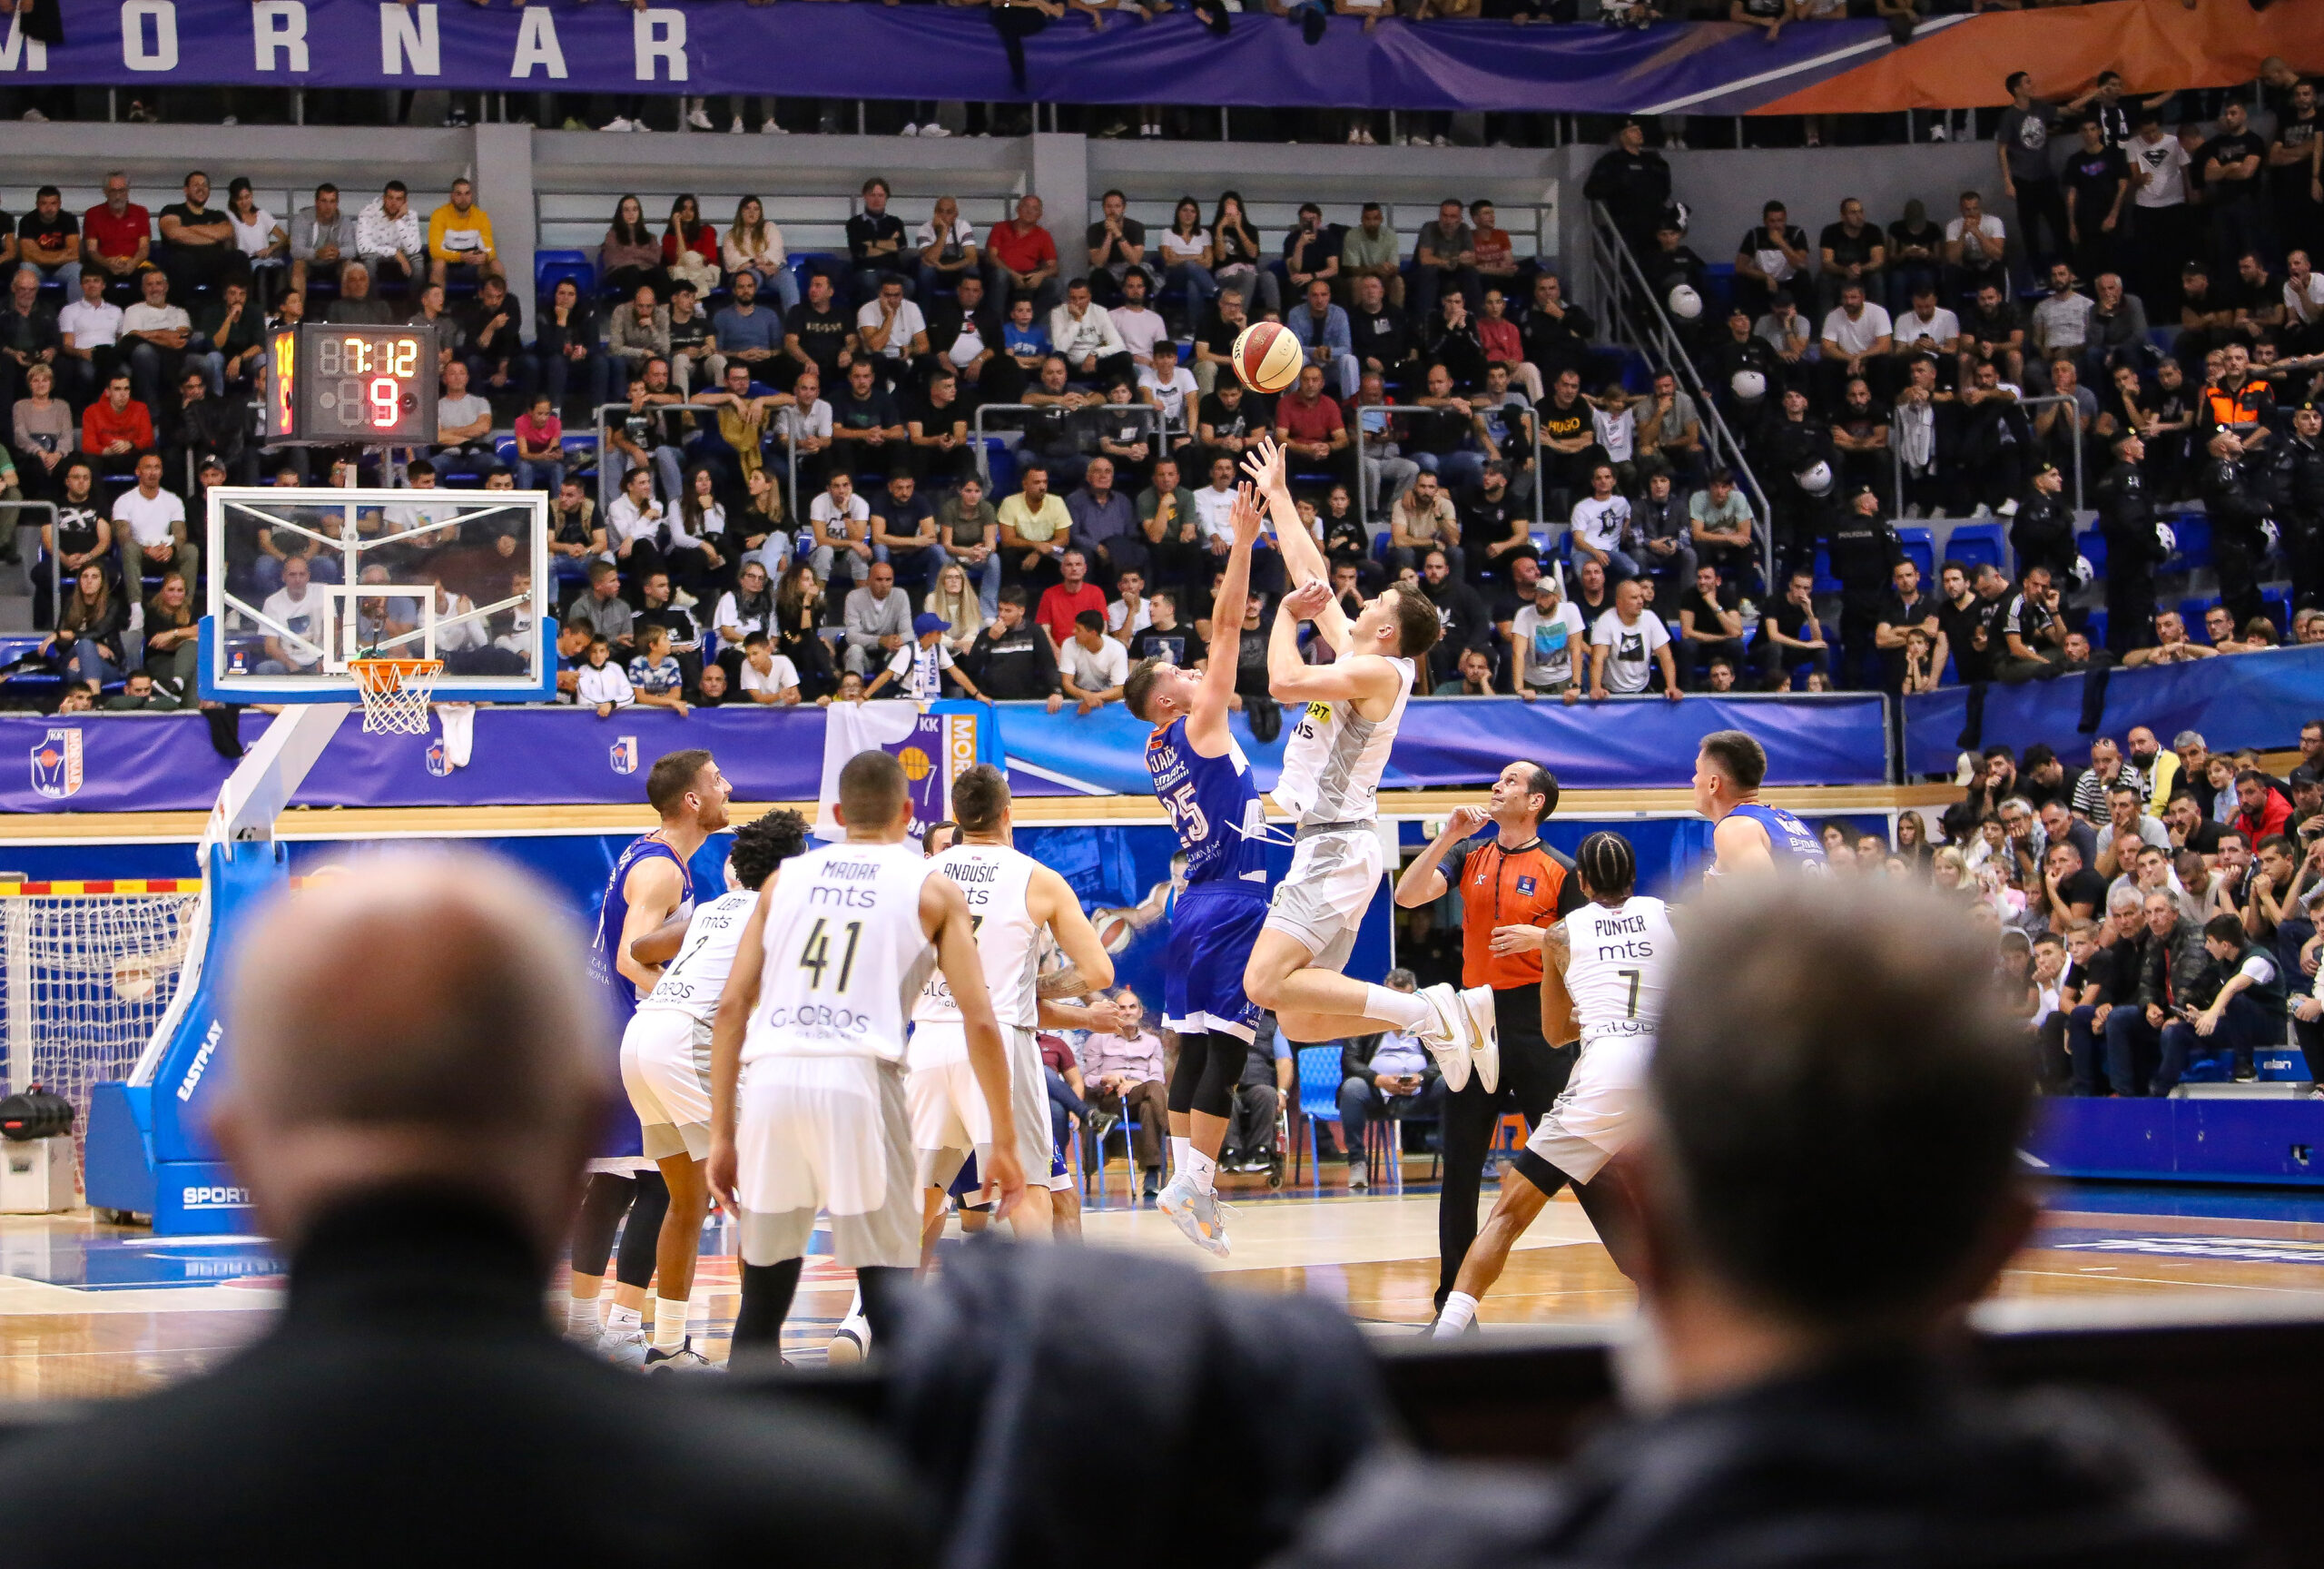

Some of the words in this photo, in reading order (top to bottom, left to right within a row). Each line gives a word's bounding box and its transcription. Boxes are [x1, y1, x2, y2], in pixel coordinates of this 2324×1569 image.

[345, 338, 418, 378] 7:12
[369, 378, 399, 427] 9
[1549, 417, 1581, 433] HUGO
[919, 716, 939, 732] KK
[953, 720, 973, 776] MOR
[908, 815, 937, 837] BA
[821, 861, 881, 880] MADAR
[810, 885, 877, 908] mts
[699, 914, 733, 929] mts
[1595, 914, 1647, 937] PUNTER
[672, 935, 709, 976] 2
[798, 917, 863, 993] 41
[1599, 940, 1653, 961] mts
[1618, 969, 1640, 1018] 7
[771, 1003, 871, 1034] GLOBOS
[177, 1019, 224, 1102] EASYPLAY
